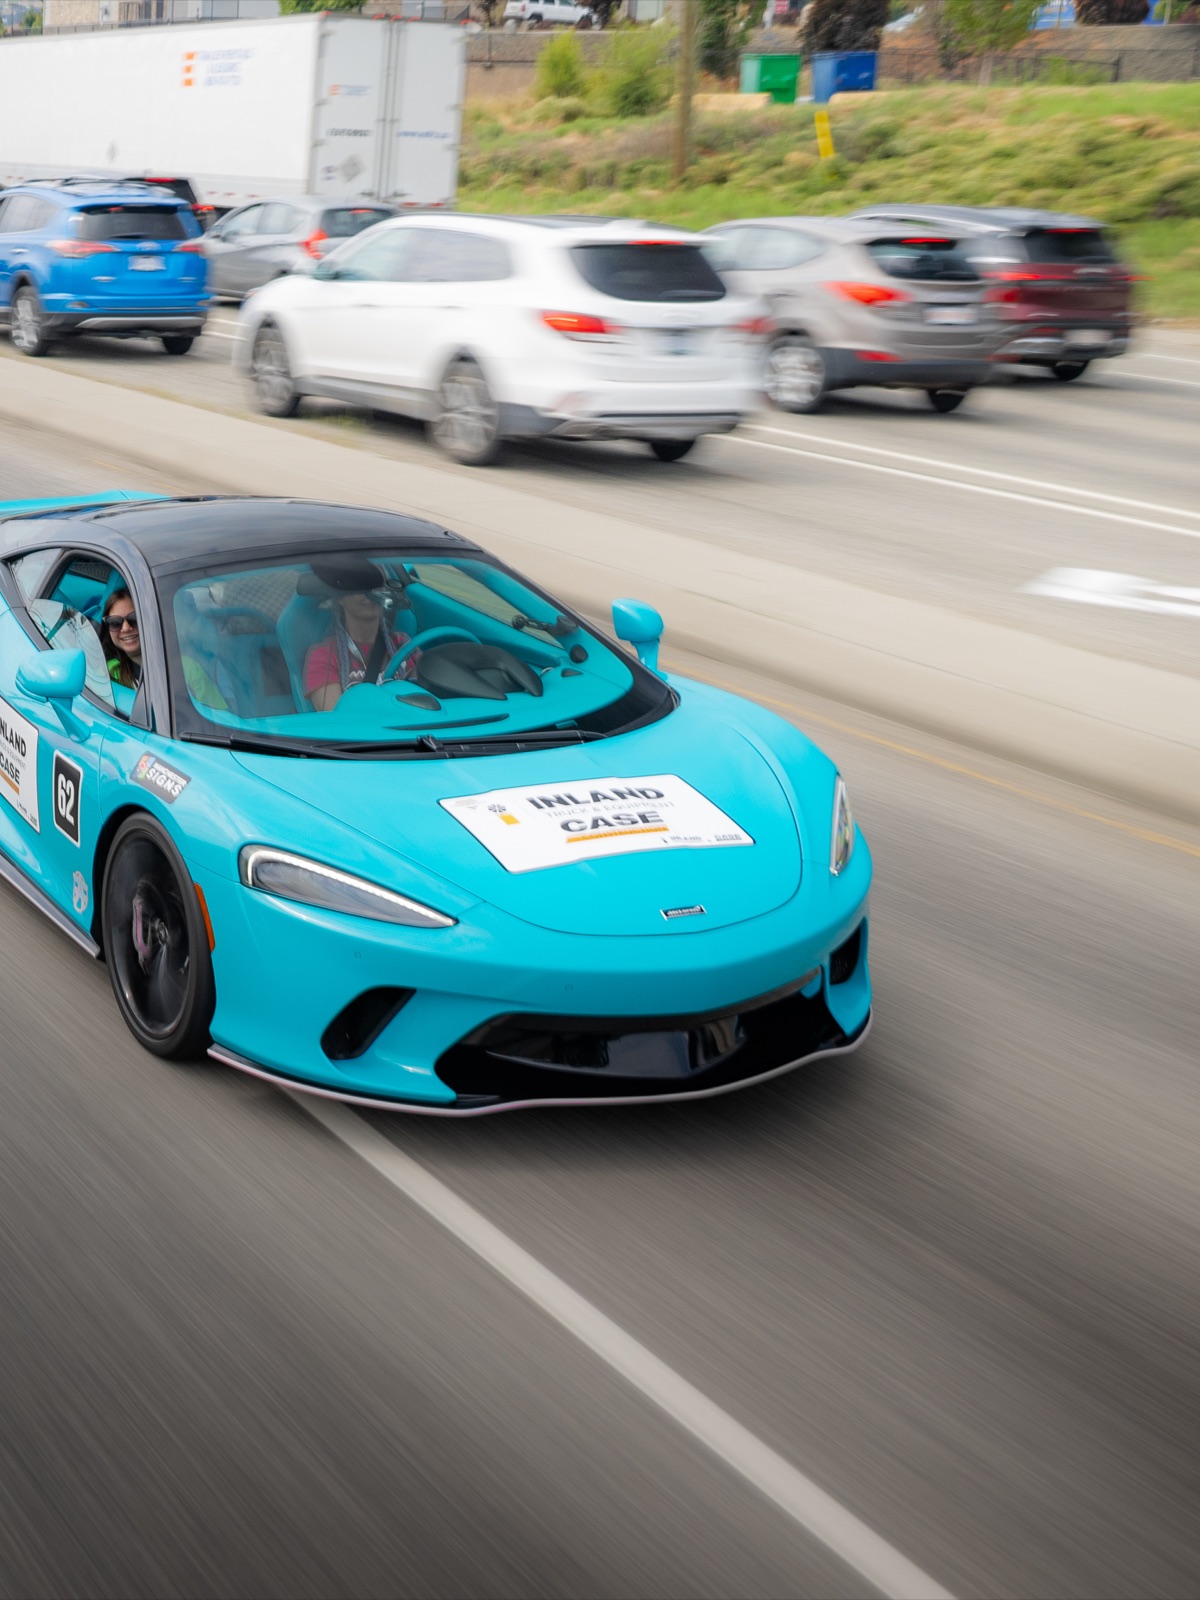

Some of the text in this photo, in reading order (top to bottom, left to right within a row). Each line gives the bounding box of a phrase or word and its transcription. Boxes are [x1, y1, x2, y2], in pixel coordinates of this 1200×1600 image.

[0, 751, 21, 784] CASE
[145, 768, 183, 797] SIGNS
[57, 773, 75, 826] 62
[525, 786, 665, 810] INLAND
[546, 807, 589, 818] TRUCK
[603, 801, 676, 812] EQUIPMENT
[560, 811, 664, 833] CASE
